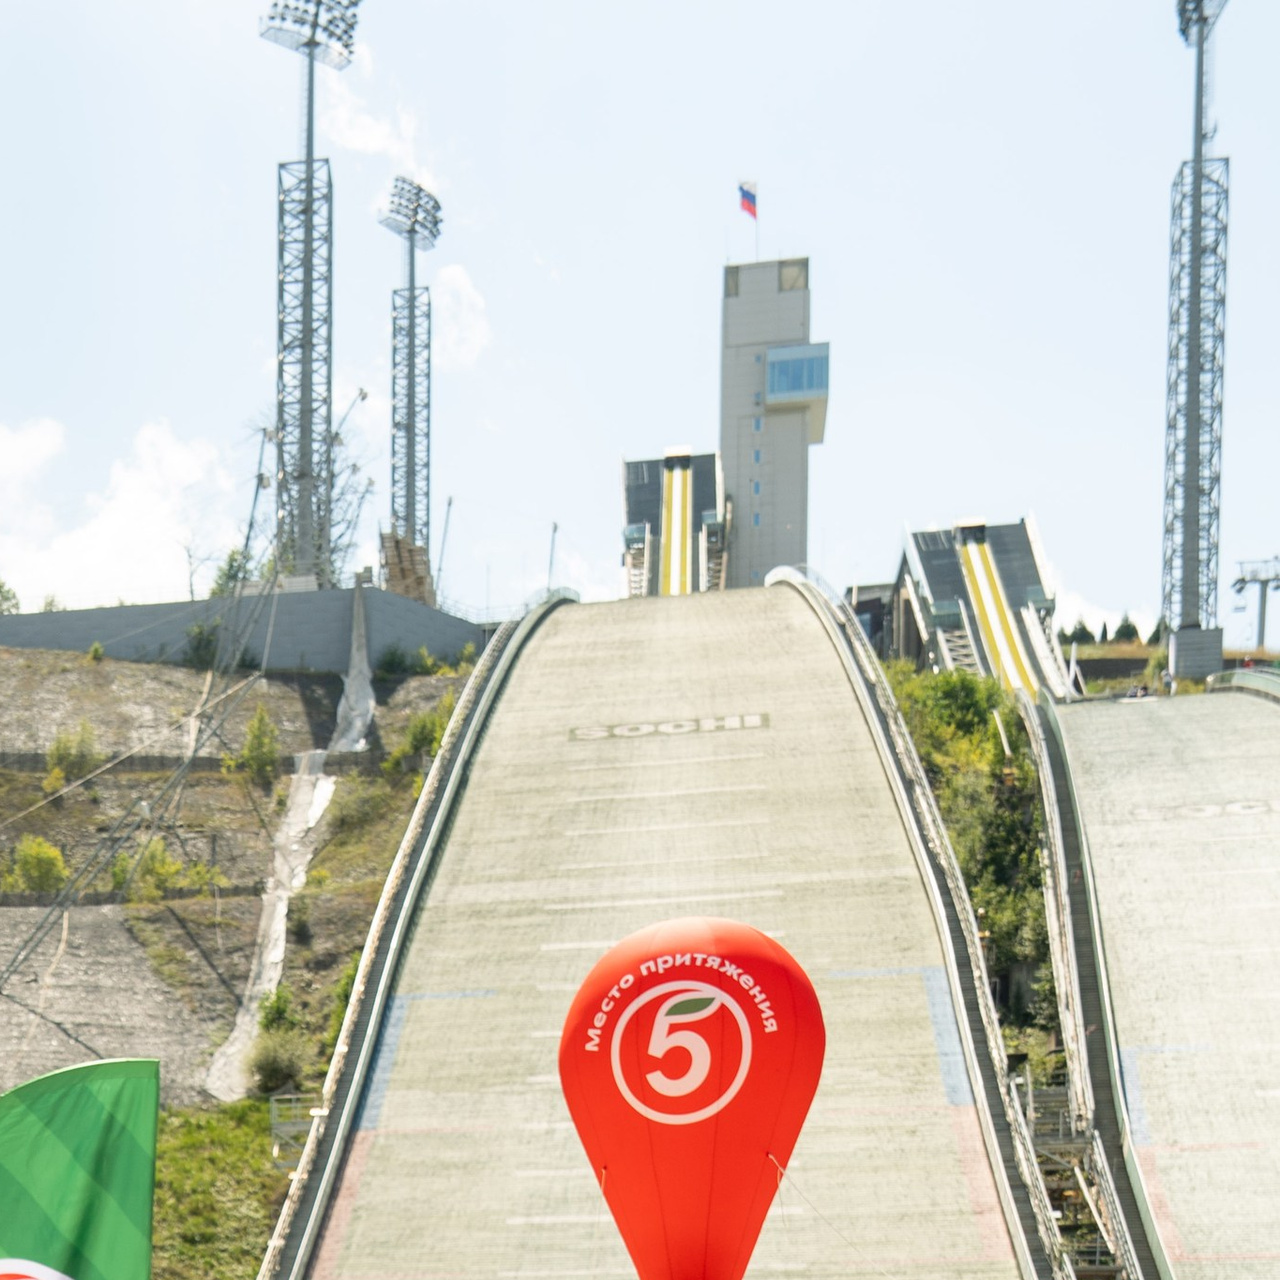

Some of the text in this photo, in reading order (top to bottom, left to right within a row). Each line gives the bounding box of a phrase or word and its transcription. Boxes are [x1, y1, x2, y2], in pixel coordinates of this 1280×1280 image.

[575, 714, 761, 739] SOCHI
[585, 953, 778, 1052] Место притяжения
[645, 990, 723, 1097] 5
